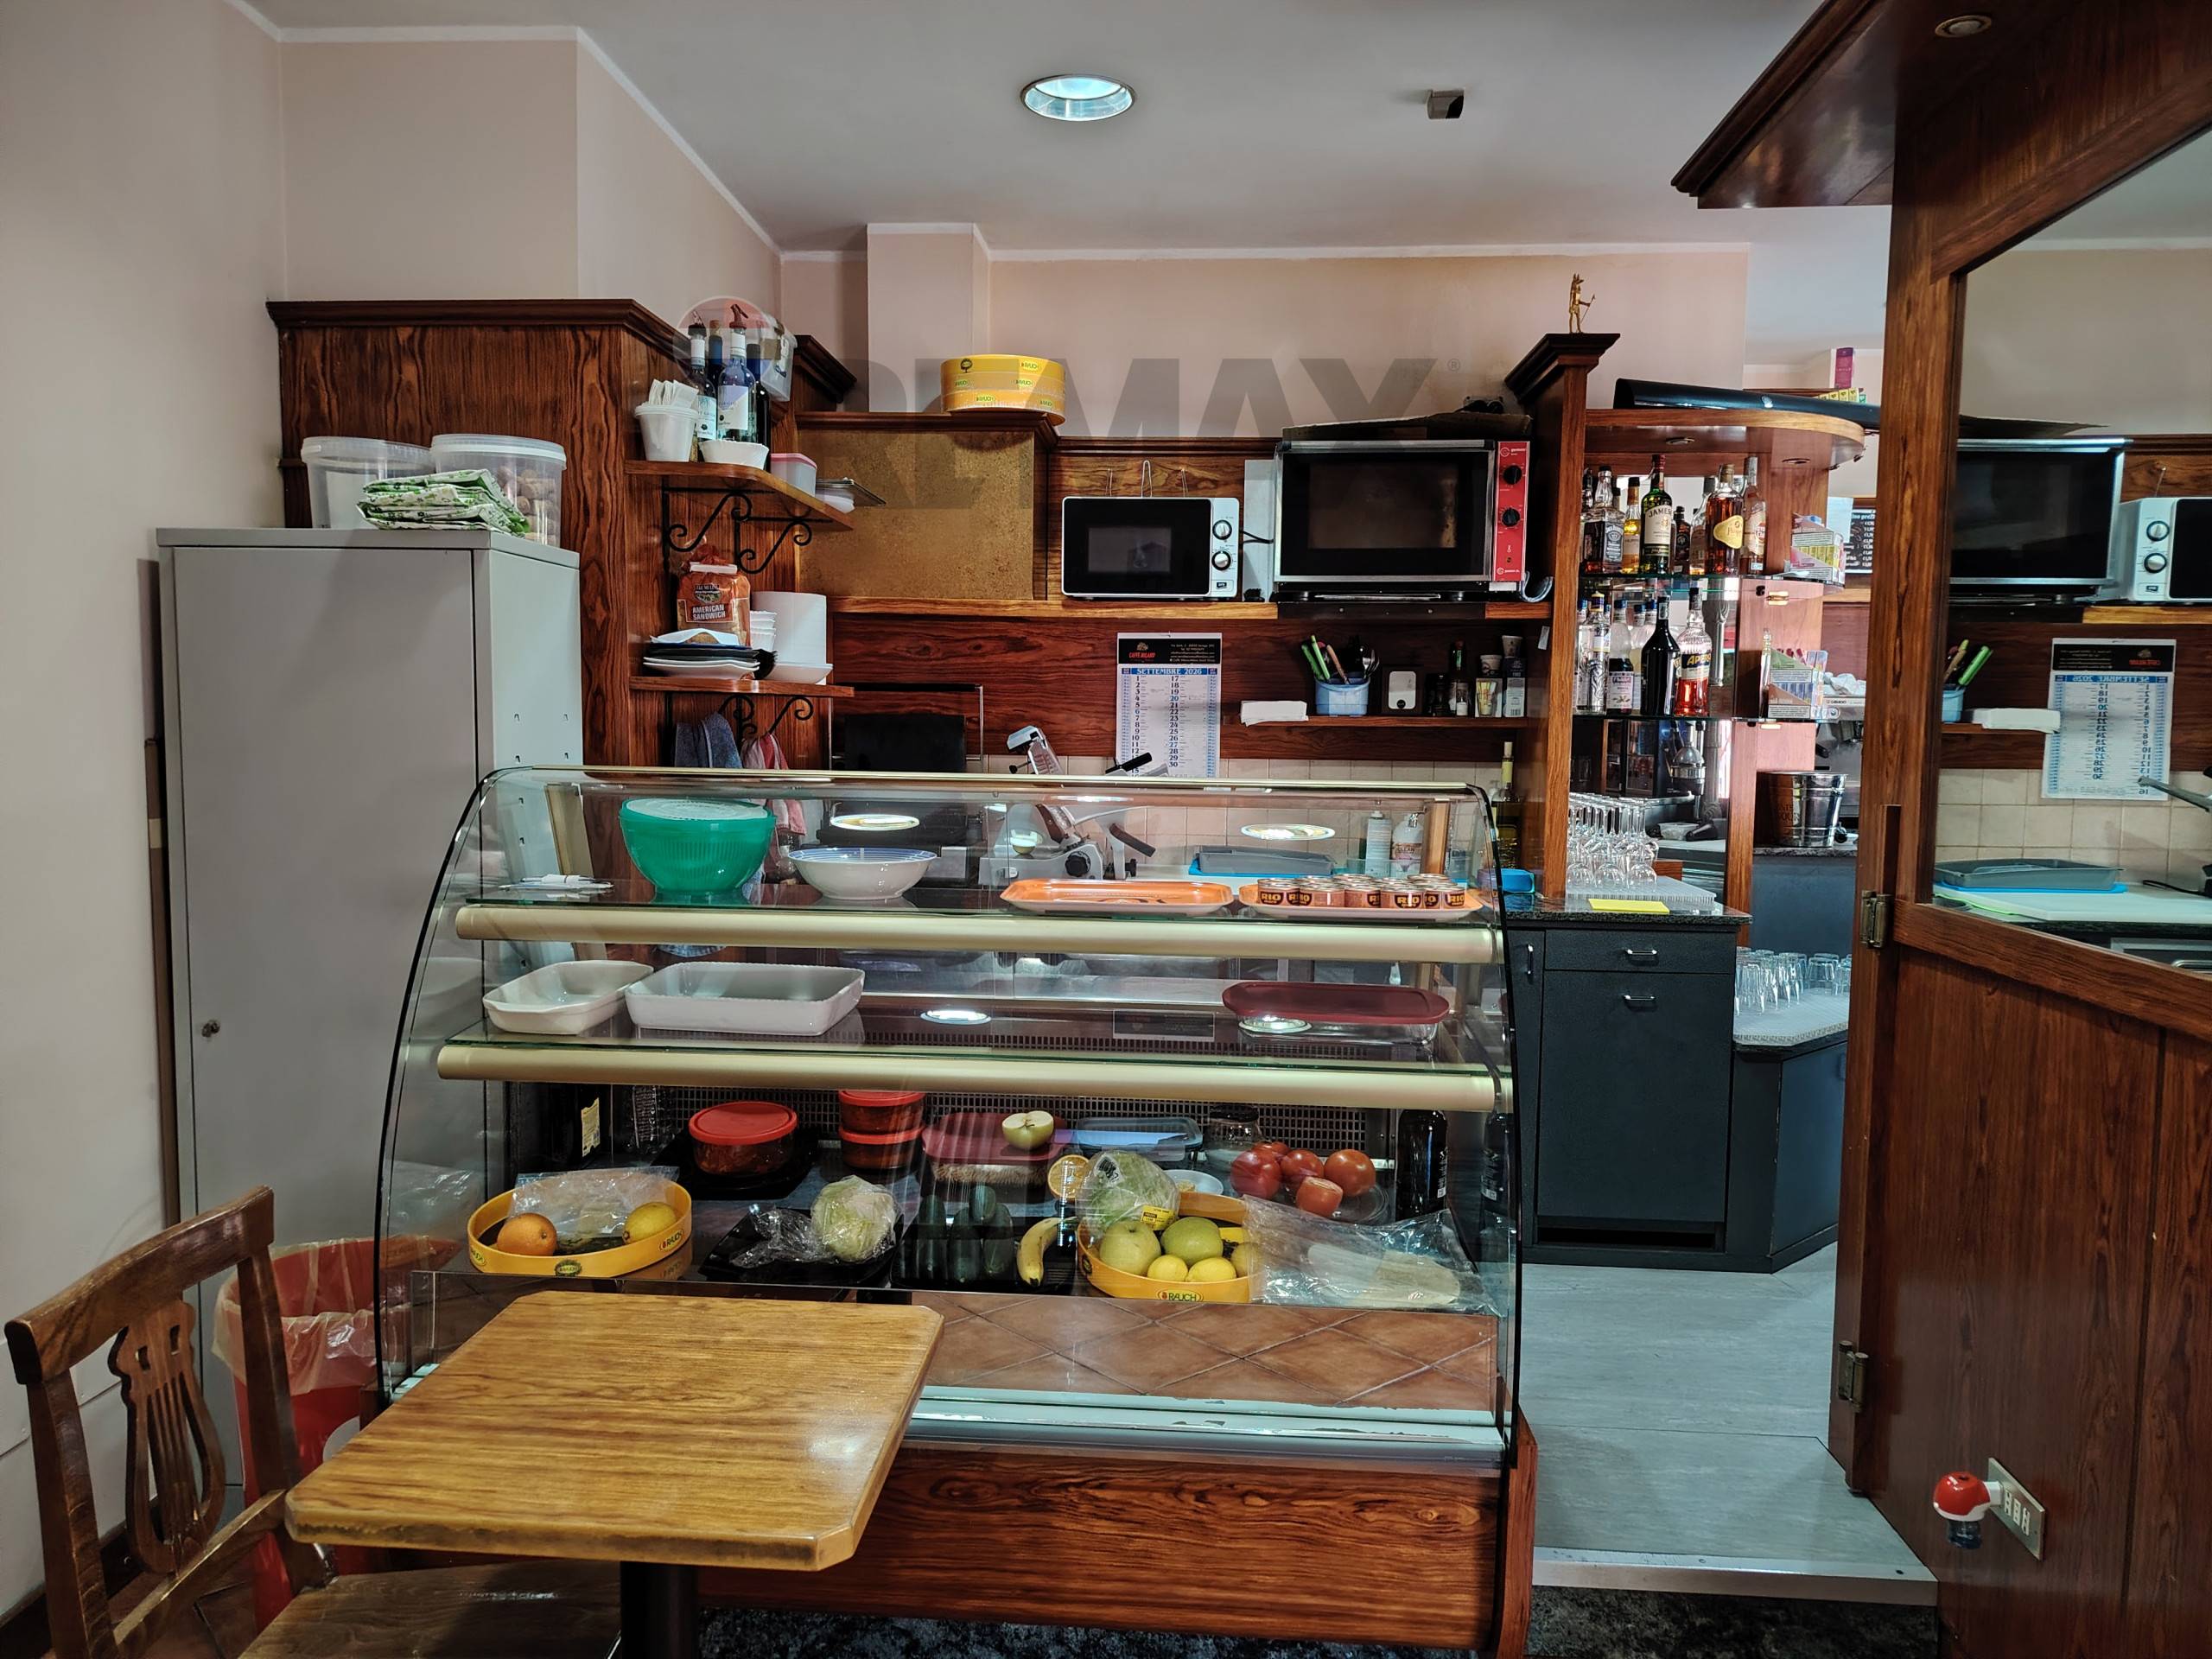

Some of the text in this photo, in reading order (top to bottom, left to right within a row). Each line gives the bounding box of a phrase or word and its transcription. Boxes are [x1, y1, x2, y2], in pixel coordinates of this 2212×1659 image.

[693, 605, 725, 613] AMERICAN
[693, 611, 726, 620] SANDWICH
[1169, 1292, 1197, 1302] RAUCH
